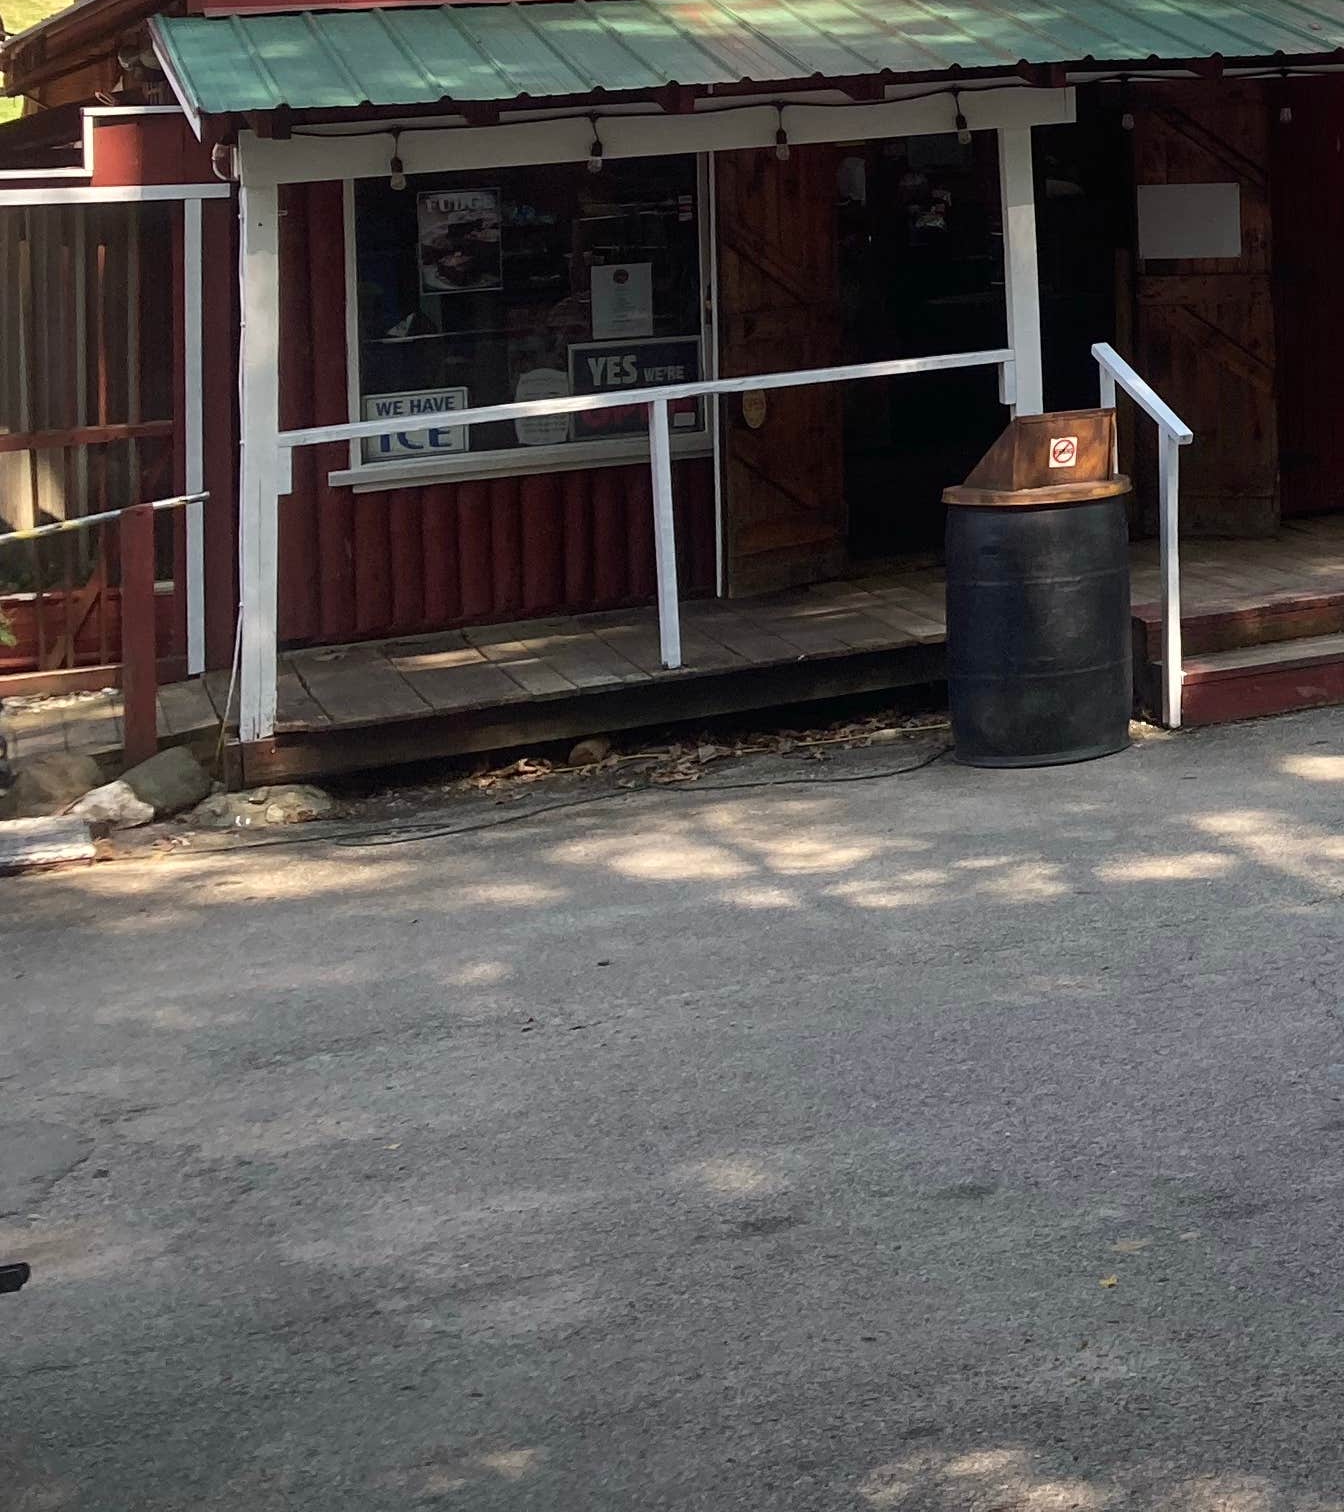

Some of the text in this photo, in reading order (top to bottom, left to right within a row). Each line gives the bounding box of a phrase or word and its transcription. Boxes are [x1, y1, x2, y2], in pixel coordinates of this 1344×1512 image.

[588, 354, 638, 386] YES
[642, 365, 686, 383] WE'RE
[376, 396, 455, 416] WE HAVE
[380, 427, 452, 453] ICE
